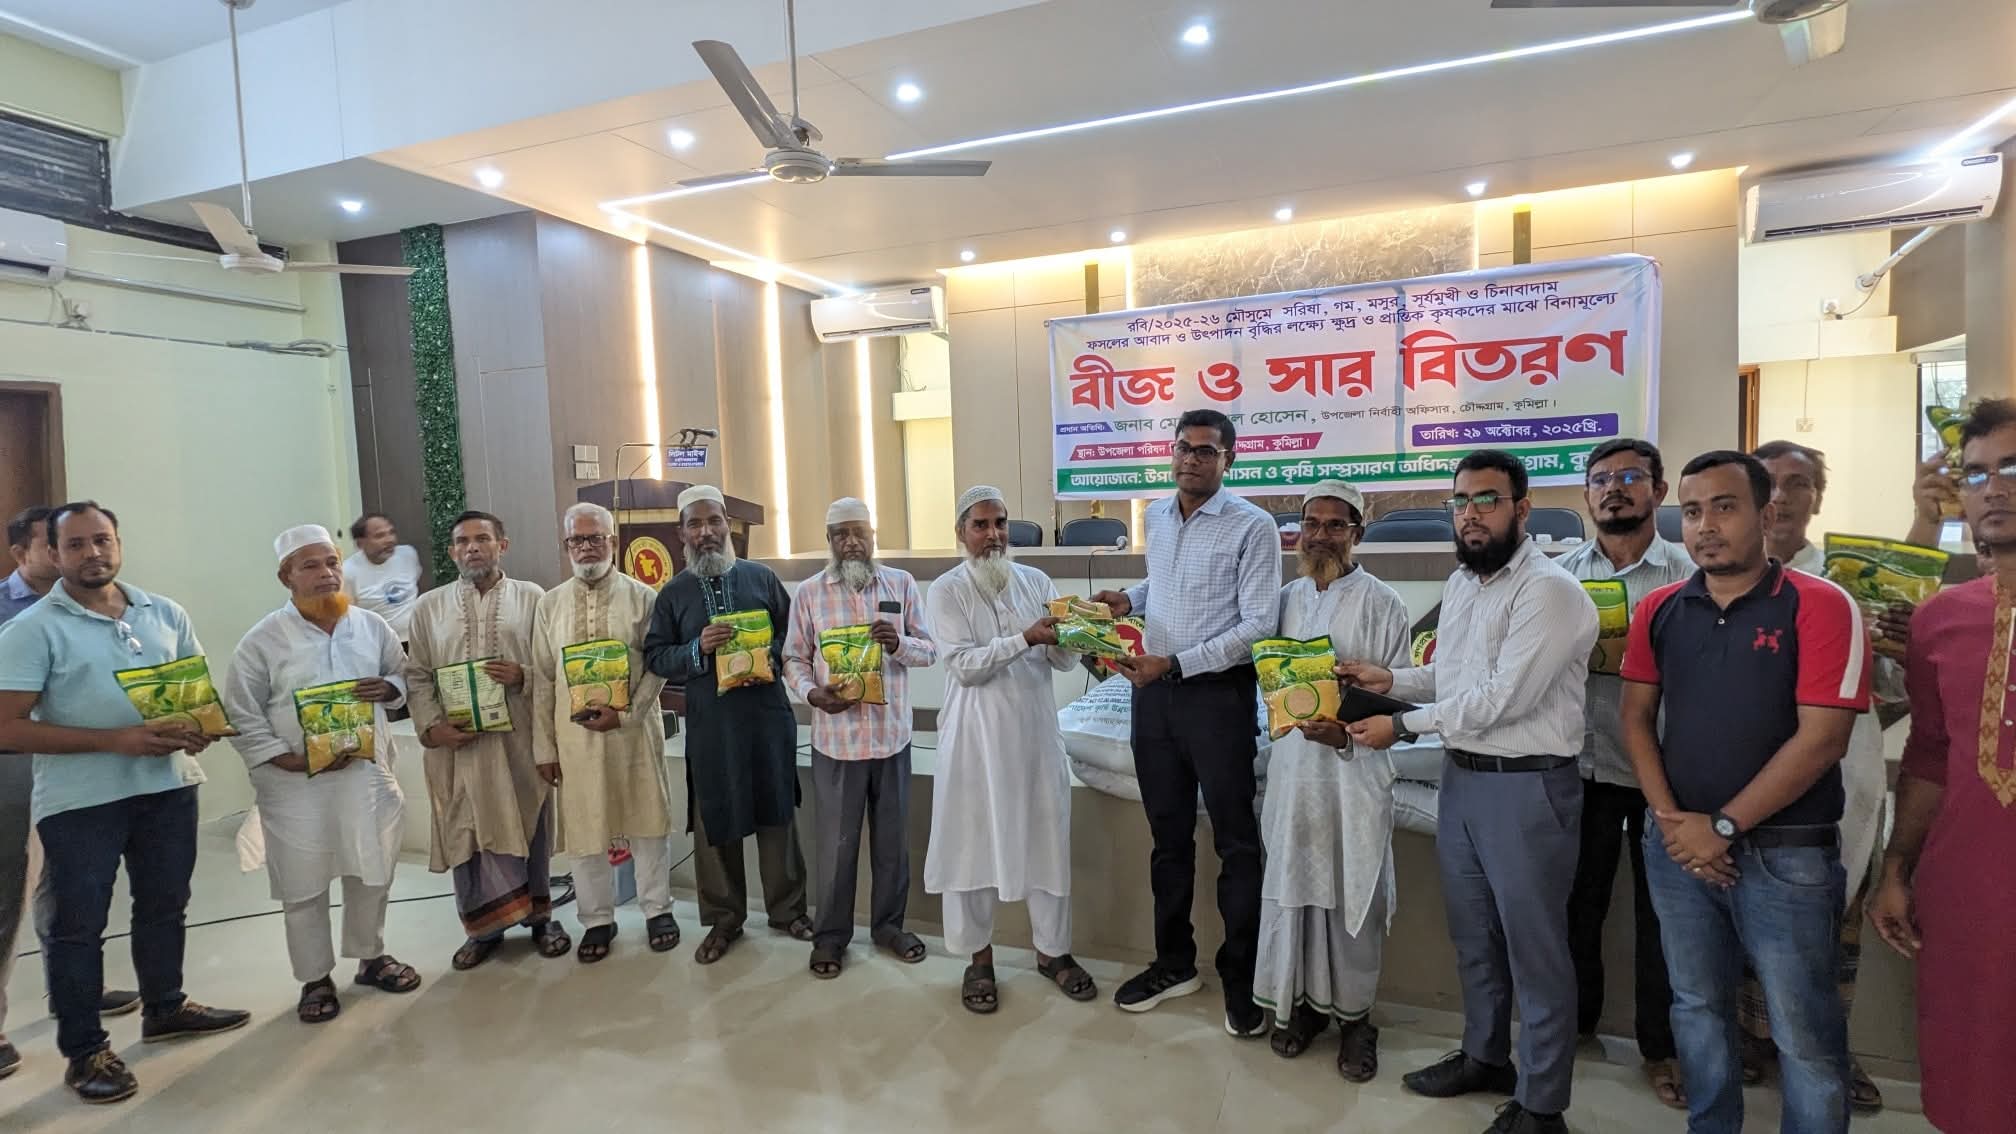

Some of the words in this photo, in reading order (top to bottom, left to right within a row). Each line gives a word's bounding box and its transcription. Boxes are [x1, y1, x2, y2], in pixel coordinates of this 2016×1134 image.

[1127, 314, 1220, 333] রবি/২০২৫-২৬
[1226, 308, 1272, 323] মৌসুমে
[1412, 286, 1461, 308] সূর্যমুখী
[1466, 289, 1479, 300] ও
[1485, 281, 1560, 299] চিনাবাদাম
[1086, 337, 1130, 351] ফসলের
[1134, 334, 1172, 347] আবাদ
[1175, 333, 1186, 343] ও
[1191, 327, 1242, 342] উৎপাদন
[1248, 321, 1282, 340] বৃদ্ধির
[1287, 319, 1325, 332] লক্ষ্যে
[1331, 316, 1357, 331] ক্ষুদ্র
[1362, 315, 1375, 325] ও
[1380, 308, 1424, 324] প্রান্তিক
[1429, 304, 1496, 324] কৃষকদের
[1501, 299, 1539, 314] মাঝে
[1544, 292, 1618, 311] বিনামূল্যে
[1069, 354, 1176, 411] বীজ
[1197, 362, 1243, 402] ও
[1266, 350, 1376, 398] সার
[1400, 329, 1628, 391] বিতরণ
[1113, 419, 1154, 432] জনাব
[1321, 409, 1365, 420] উপজেলা
[1368, 405, 1402, 418] নির্বাহী
[1463, 428, 1481, 439] ২৯
[1097, 446, 1135, 457] উপজেলা
[1137, 443, 1166, 455] পরিষদ
[1265, 466, 1278, 478] ও
[1281, 460, 1314, 482] কৃষি
[1317, 461, 1395, 478] সম্প্রসারণ
